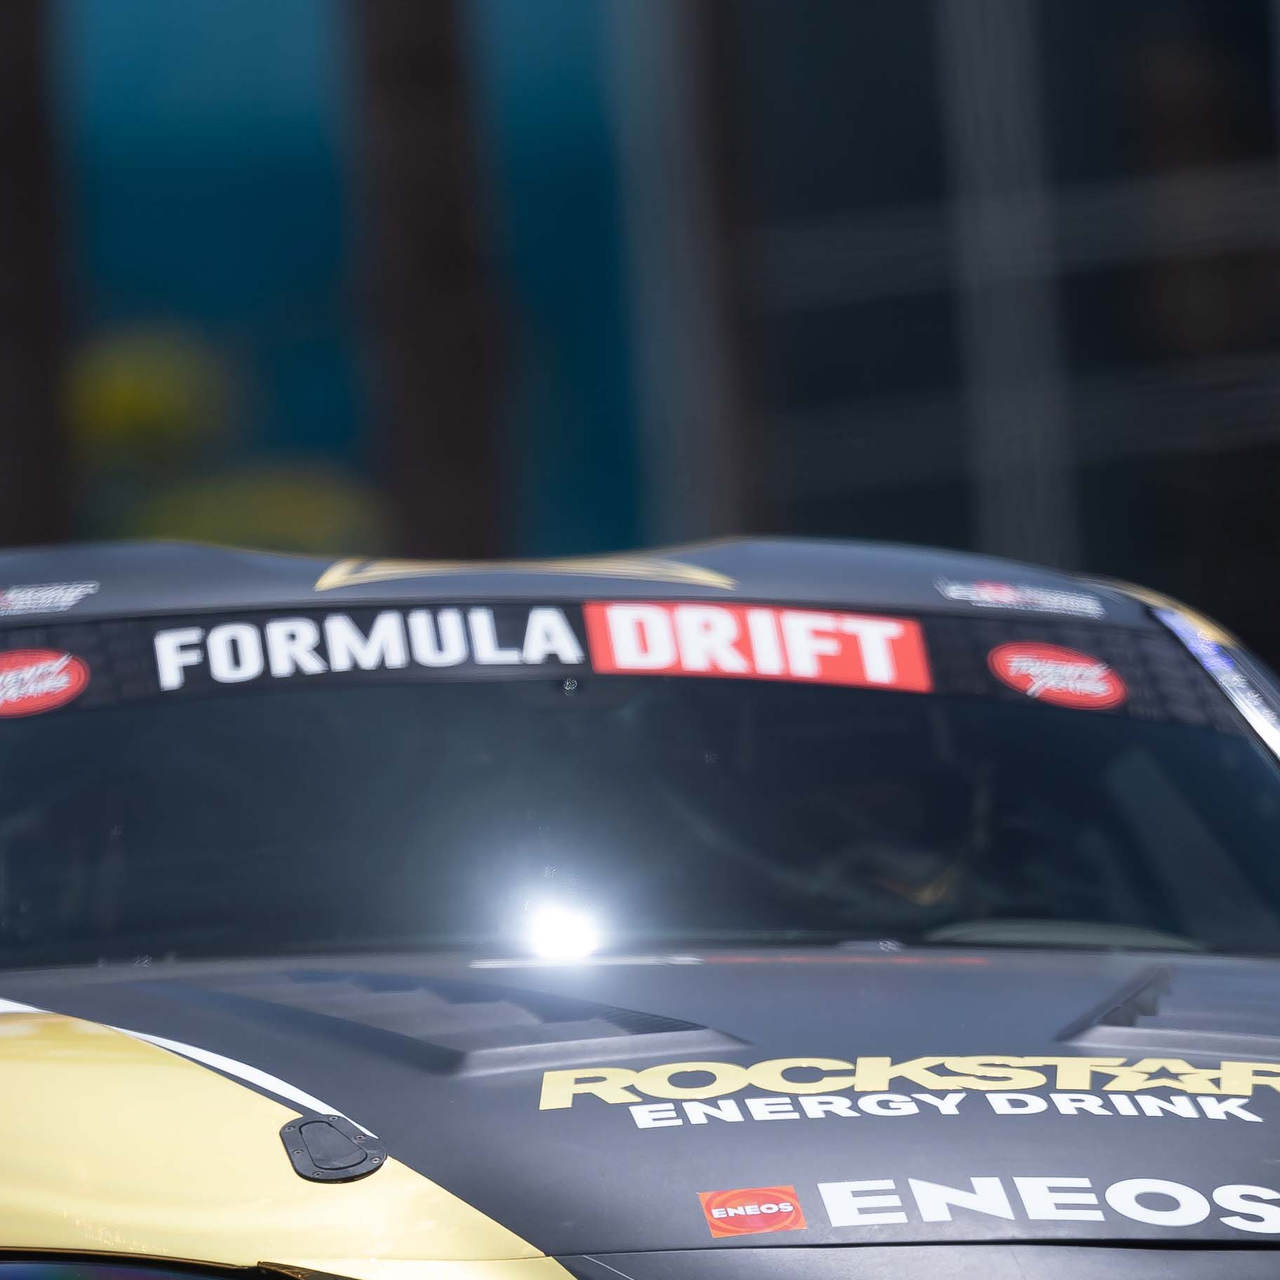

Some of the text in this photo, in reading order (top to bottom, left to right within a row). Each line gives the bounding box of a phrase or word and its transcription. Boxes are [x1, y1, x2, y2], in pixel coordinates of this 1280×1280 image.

[153, 602, 904, 691] FORMULA DRIFT
[627, 1091, 1266, 1130] ENERGY DRINK
[711, 1202, 794, 1219] ENEOS
